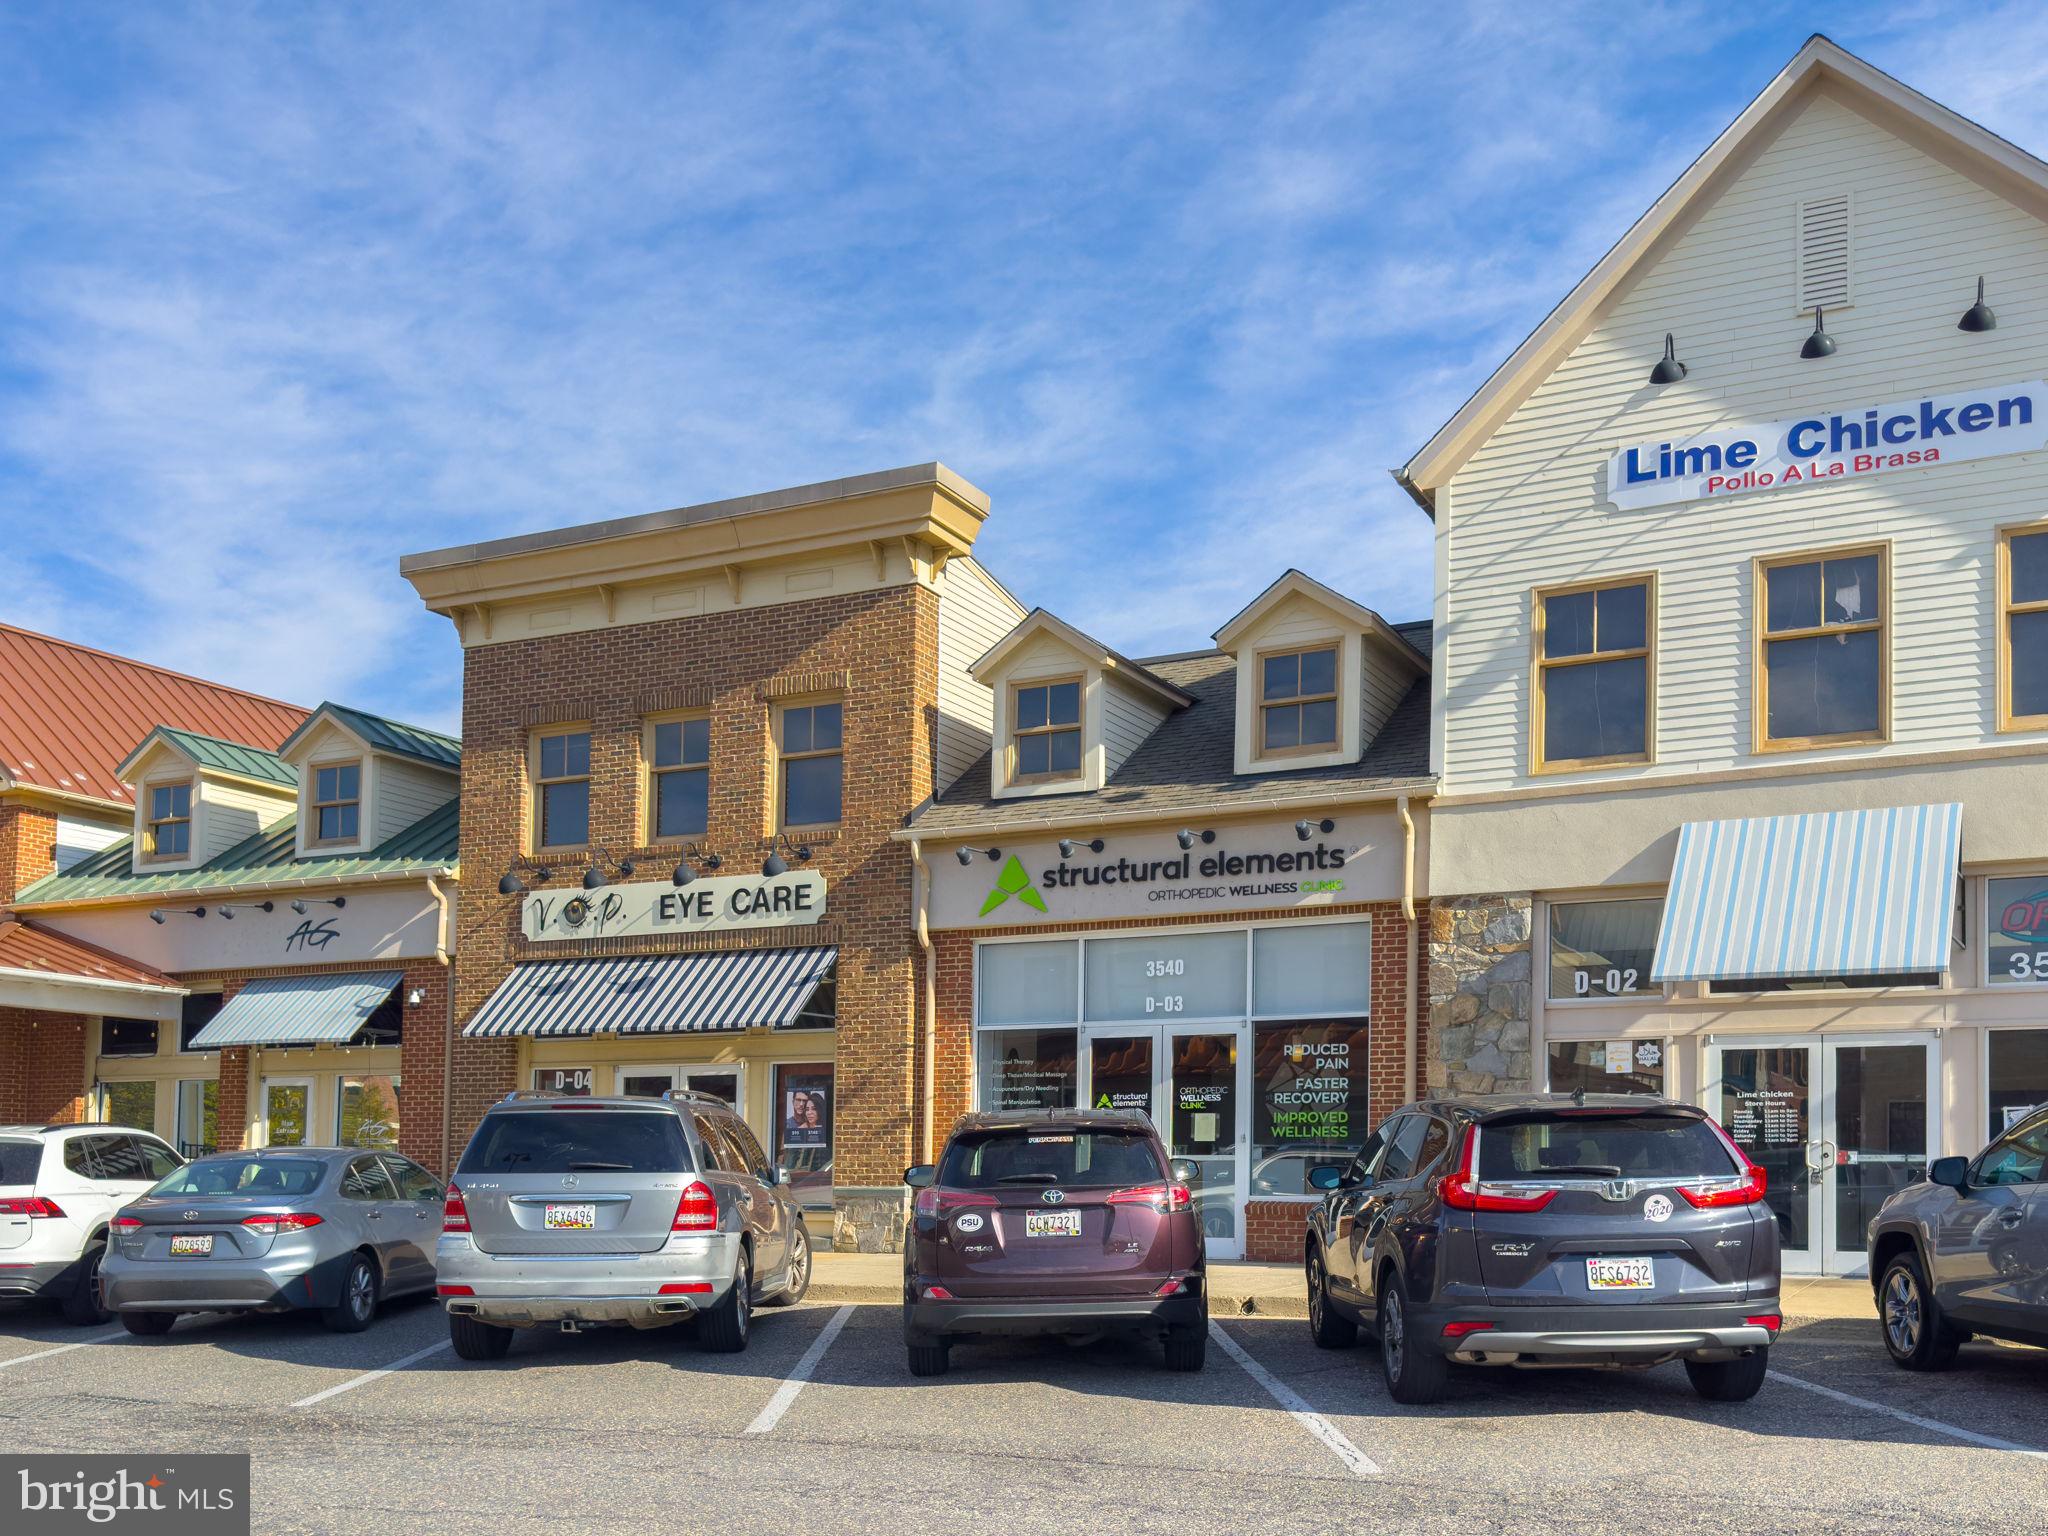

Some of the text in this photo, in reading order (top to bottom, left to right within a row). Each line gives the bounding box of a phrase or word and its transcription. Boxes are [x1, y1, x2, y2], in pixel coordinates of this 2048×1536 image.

[1626, 395, 2033, 485] Lime Chicken
[1708, 447, 1941, 493] Pollo A La Brasa
[1042, 843, 1346, 888] structural elements
[1148, 886, 1226, 902] ORTHOPEDIC
[1229, 881, 1298, 897] WELLNESS
[659, 890, 715, 920] EYE
[731, 883, 812, 914] CARE
[285, 917, 340, 952] AG
[1146, 959, 1184, 977] 3540
[1574, 968, 1638, 994] D-02
[1145, 996, 1184, 1013] D-03
[1283, 1044, 1349, 1056] REDUCED
[1315, 1058, 1349, 1069] PAIN
[555, 1070, 592, 1090] D-04
[1295, 1077, 1349, 1090] FASTER
[1112, 1092, 1149, 1101] structural
[1179, 1086, 1229, 1094] ORTHOPEDIC
[1736, 1090, 1794, 1099] Lime Chicken
[1112, 1100, 1146, 1108] elements
[1180, 1094, 1221, 1102] WELLNESS
[1274, 1091, 1349, 1104] RECOVERY
[1273, 1111, 1349, 1123] IMPROVED
[1271, 1126, 1349, 1138] WELLNESS
[1645, 1203, 1673, 1219] 2020
[960, 1218, 979, 1227] PSU
[1491, 1242, 1536, 1252] CR-V
[1590, 1265, 1650, 1281] 8ES6732
